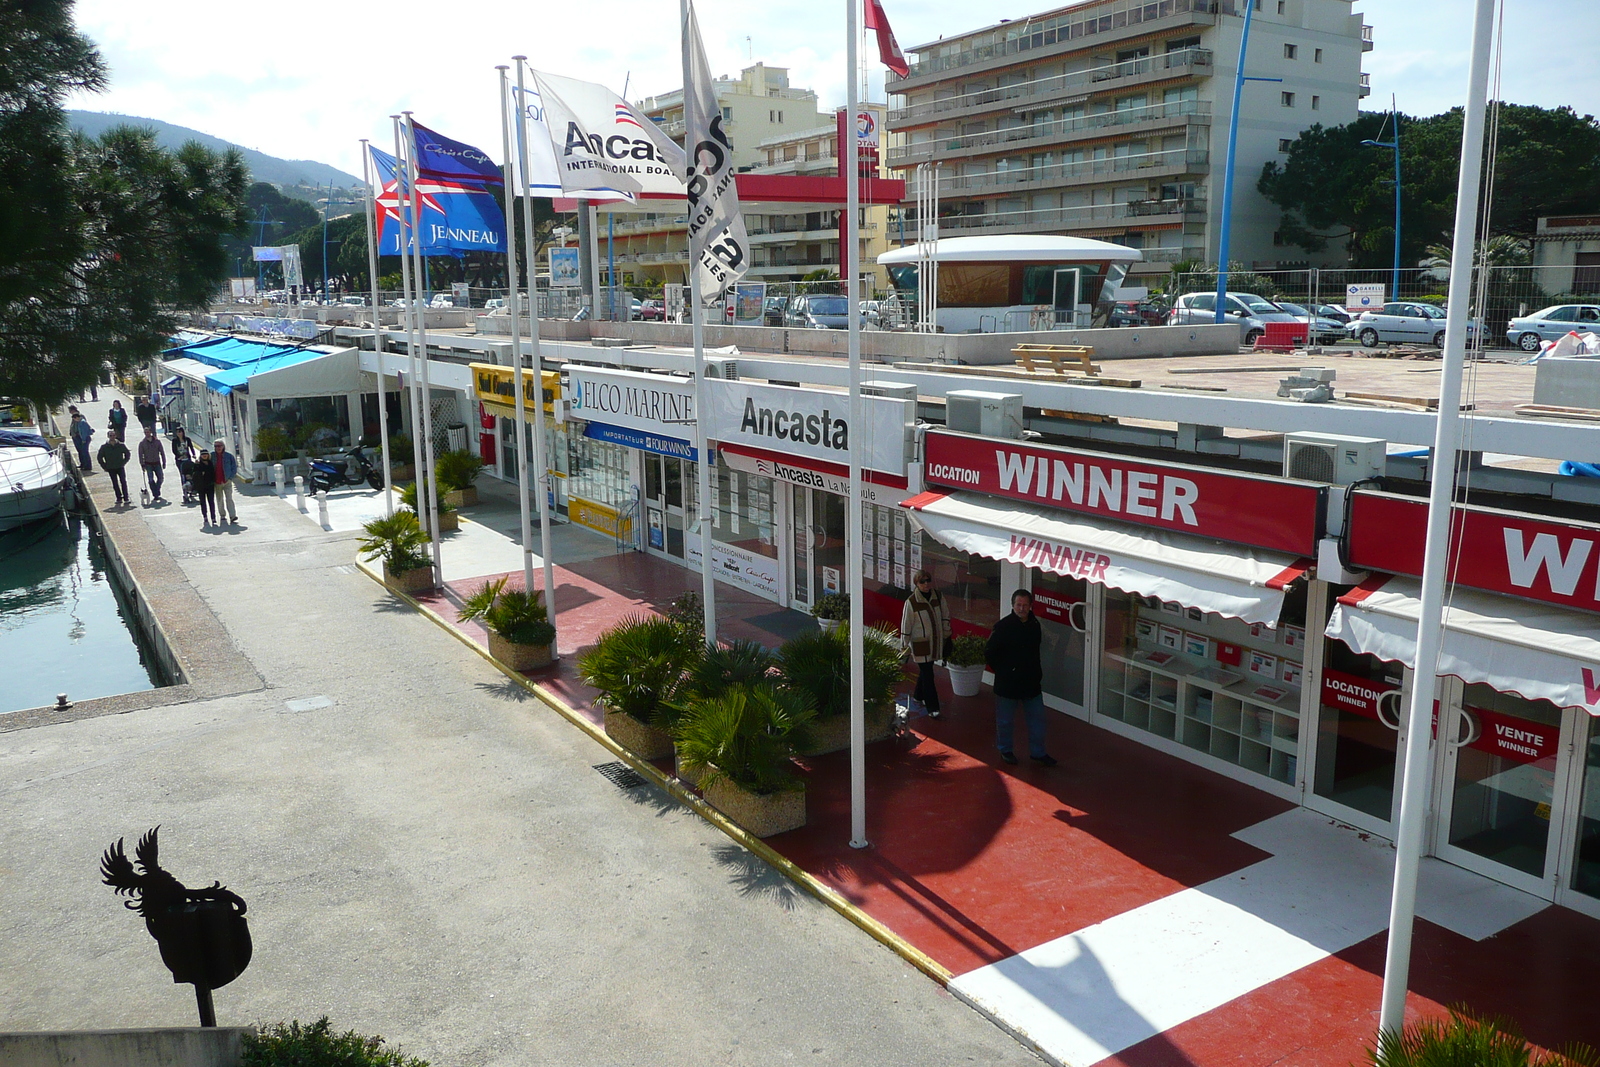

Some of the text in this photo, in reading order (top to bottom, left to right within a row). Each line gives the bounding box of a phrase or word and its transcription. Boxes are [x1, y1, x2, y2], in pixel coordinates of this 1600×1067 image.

[583, 381, 621, 413] ELCO
[624, 387, 692, 426] MARINE
[603, 430, 644, 444] IMPORTATEUR
[741, 397, 849, 451] Ancasta
[774, 462, 825, 488] Ancasta
[828, 479, 839, 492] La
[928, 450, 1199, 526] LOCATION WINNER
[1008, 535, 1111, 580] WINNER
[1326, 678, 1380, 701] LOCATION
[1337, 694, 1367, 708] WINNER
[1495, 724, 1544, 747] VENTE
[1497, 739, 1538, 757] WINNER
